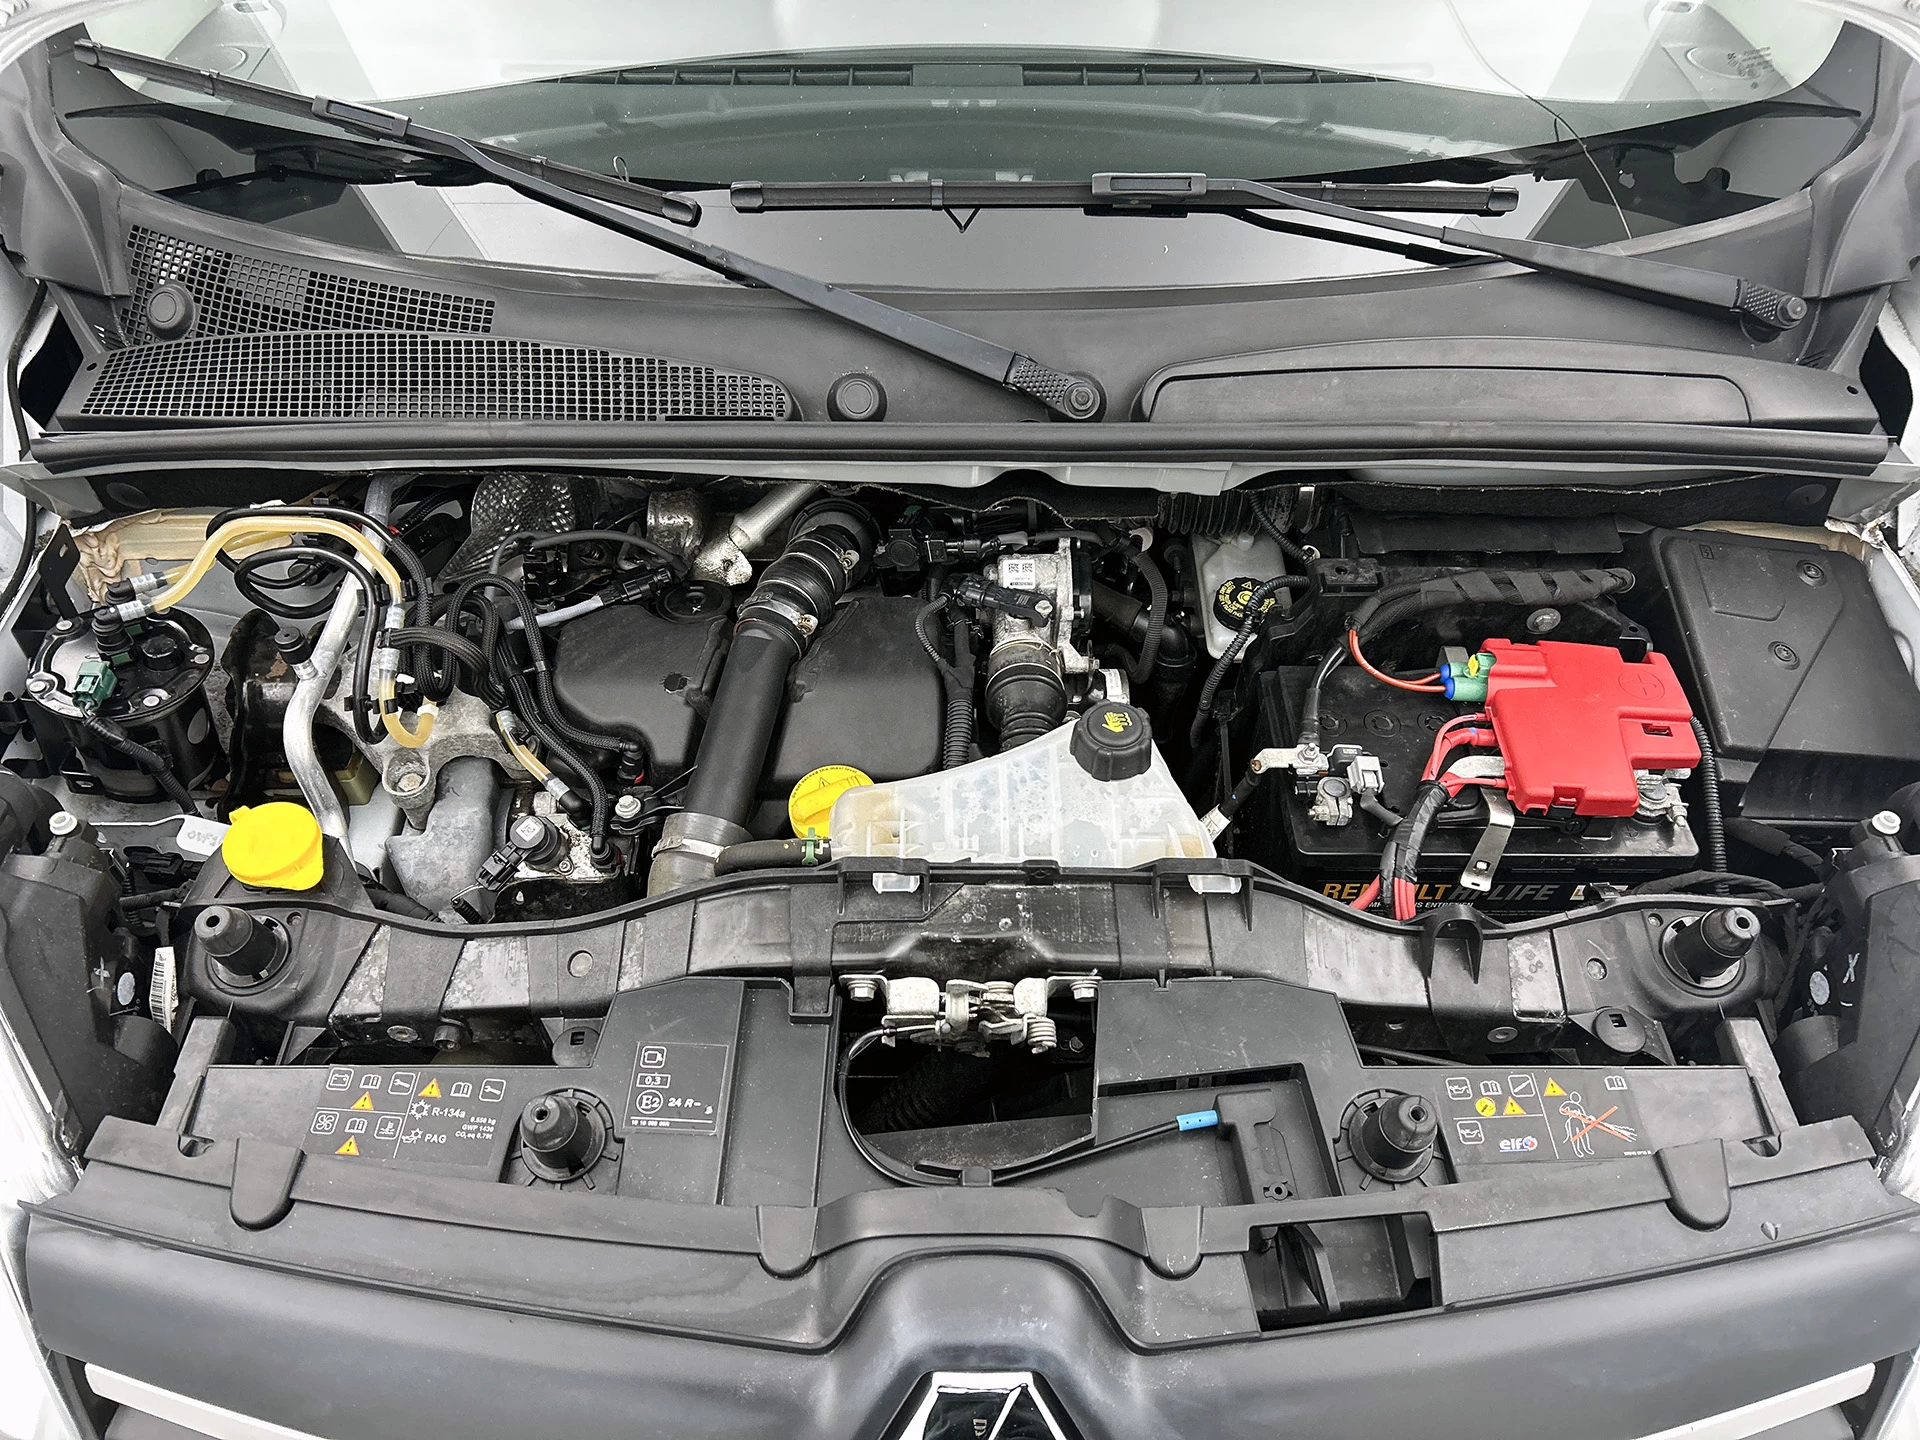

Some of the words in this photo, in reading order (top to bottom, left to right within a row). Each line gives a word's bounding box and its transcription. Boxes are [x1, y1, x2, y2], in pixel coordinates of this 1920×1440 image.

[1322, 883, 1451, 900] RELT
[640, 1095, 660, 1109] E2
[667, 1097, 682, 1107] 24
[431, 1107, 466, 1118] R-134a
[488, 1117, 497, 1125] kg
[461, 1123, 479, 1131] GWP
[479, 1125, 495, 1133] 1430
[424, 1133, 447, 1143] PAG
[1500, 1137, 1524, 1150] elf
